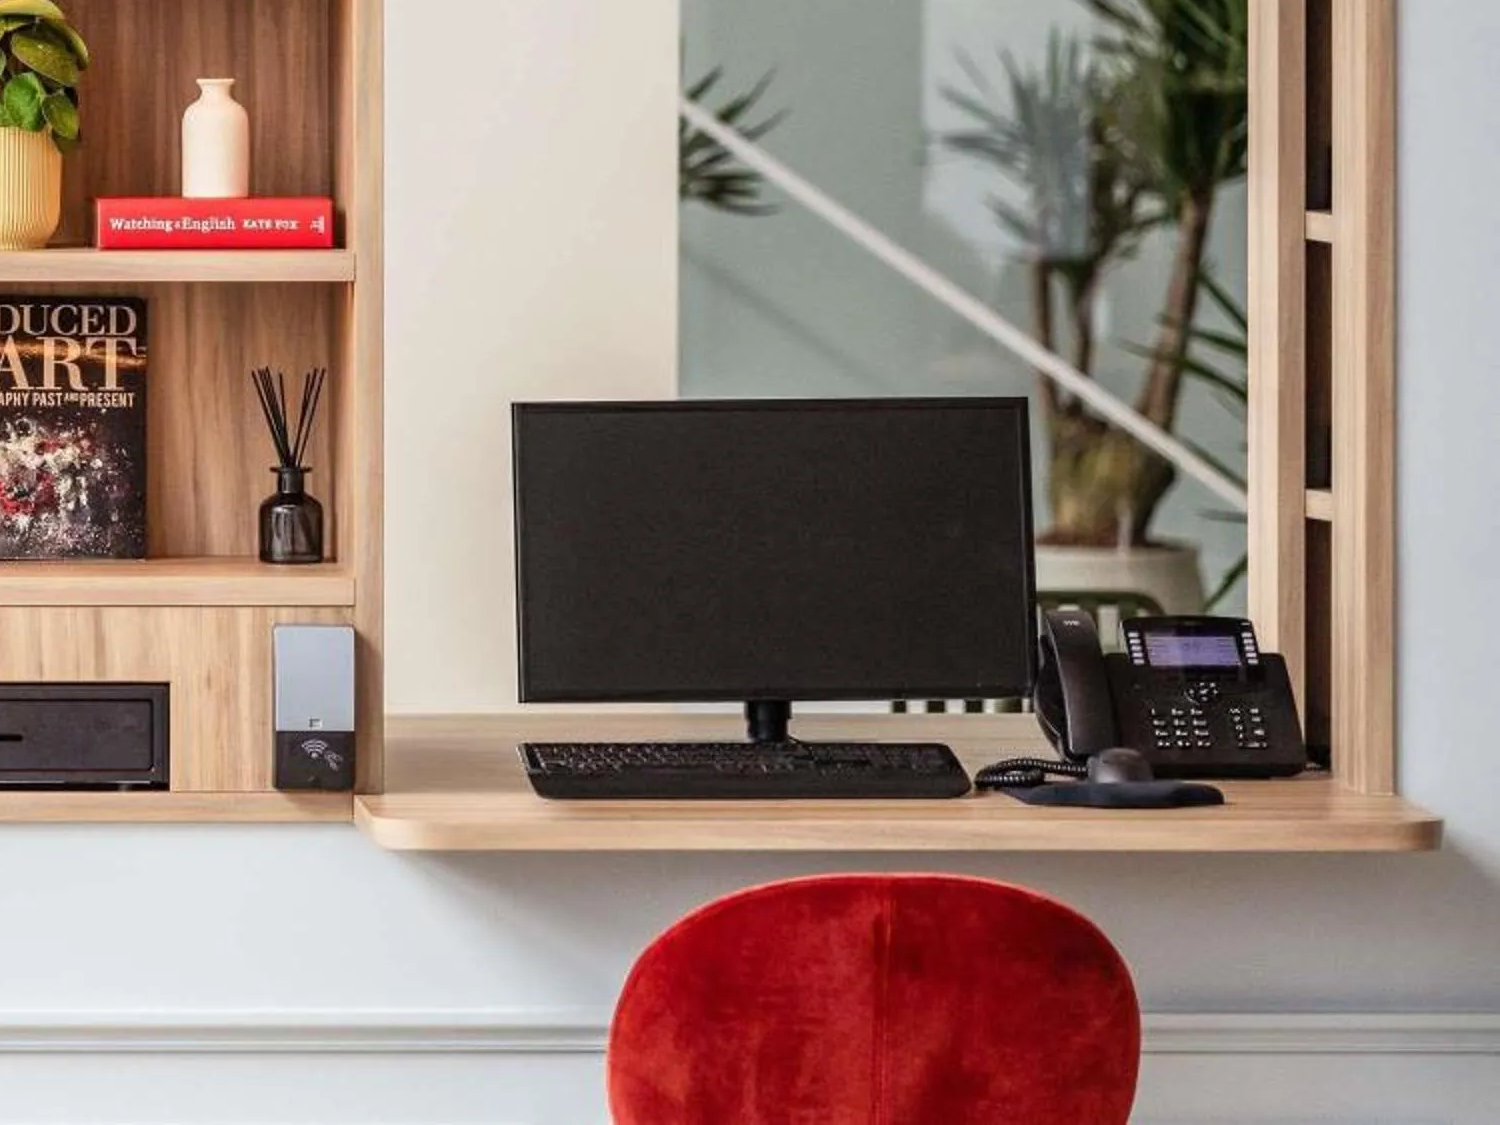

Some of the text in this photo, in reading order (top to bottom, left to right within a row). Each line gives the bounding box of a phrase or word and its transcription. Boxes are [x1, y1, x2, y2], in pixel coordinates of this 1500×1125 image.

[109, 216, 298, 233] Watching English KATE FOX
[32, 392, 62, 407] PAST
[64, 392, 79, 403] AND
[80, 392, 135, 408] PRESENT
